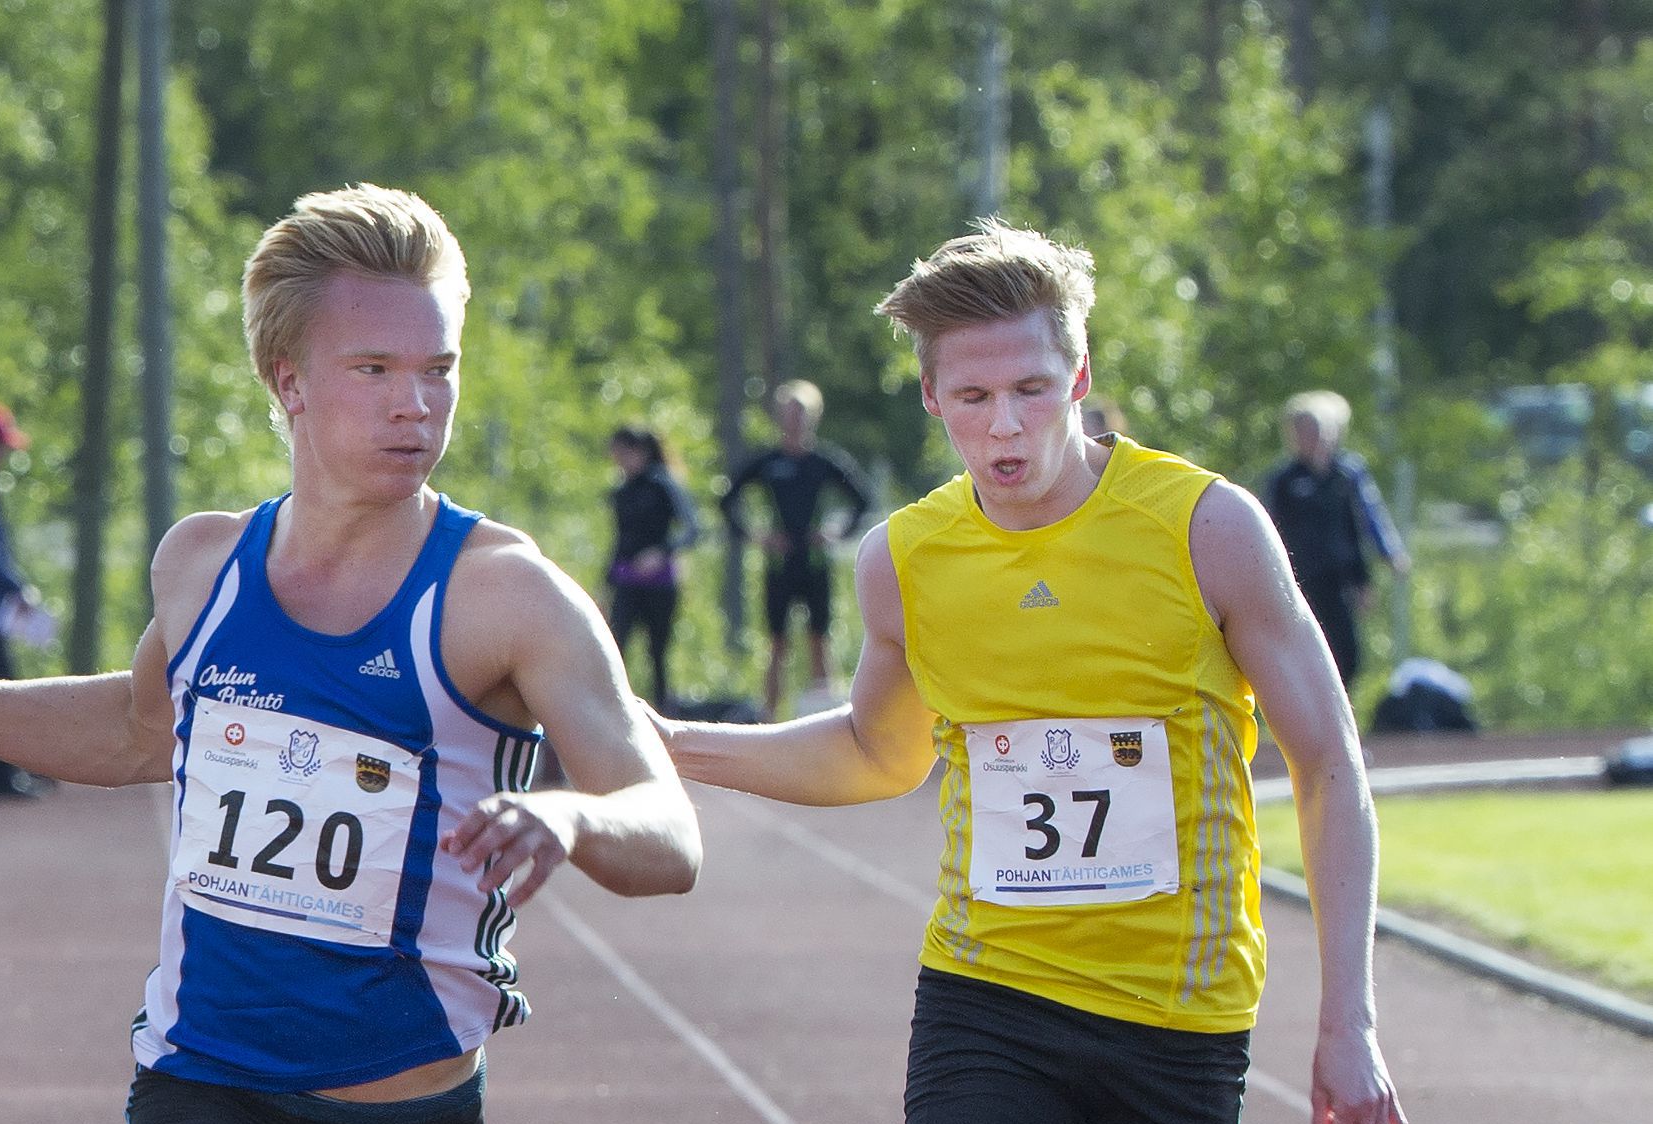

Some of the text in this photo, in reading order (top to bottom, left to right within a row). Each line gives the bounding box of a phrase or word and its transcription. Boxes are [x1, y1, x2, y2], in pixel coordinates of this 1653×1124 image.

[198, 664, 257, 687] Oulun
[358, 665, 401, 680] adidas
[204, 750, 260, 770] Osuuspankki
[983, 762, 1028, 773] Osuuspankki
[1022, 789, 1111, 860] 37
[208, 789, 363, 890] 120
[996, 863, 1153, 882] POHJANTÄHTIGAMES
[188, 871, 365, 919] POHJANTÄHTIGAMES
